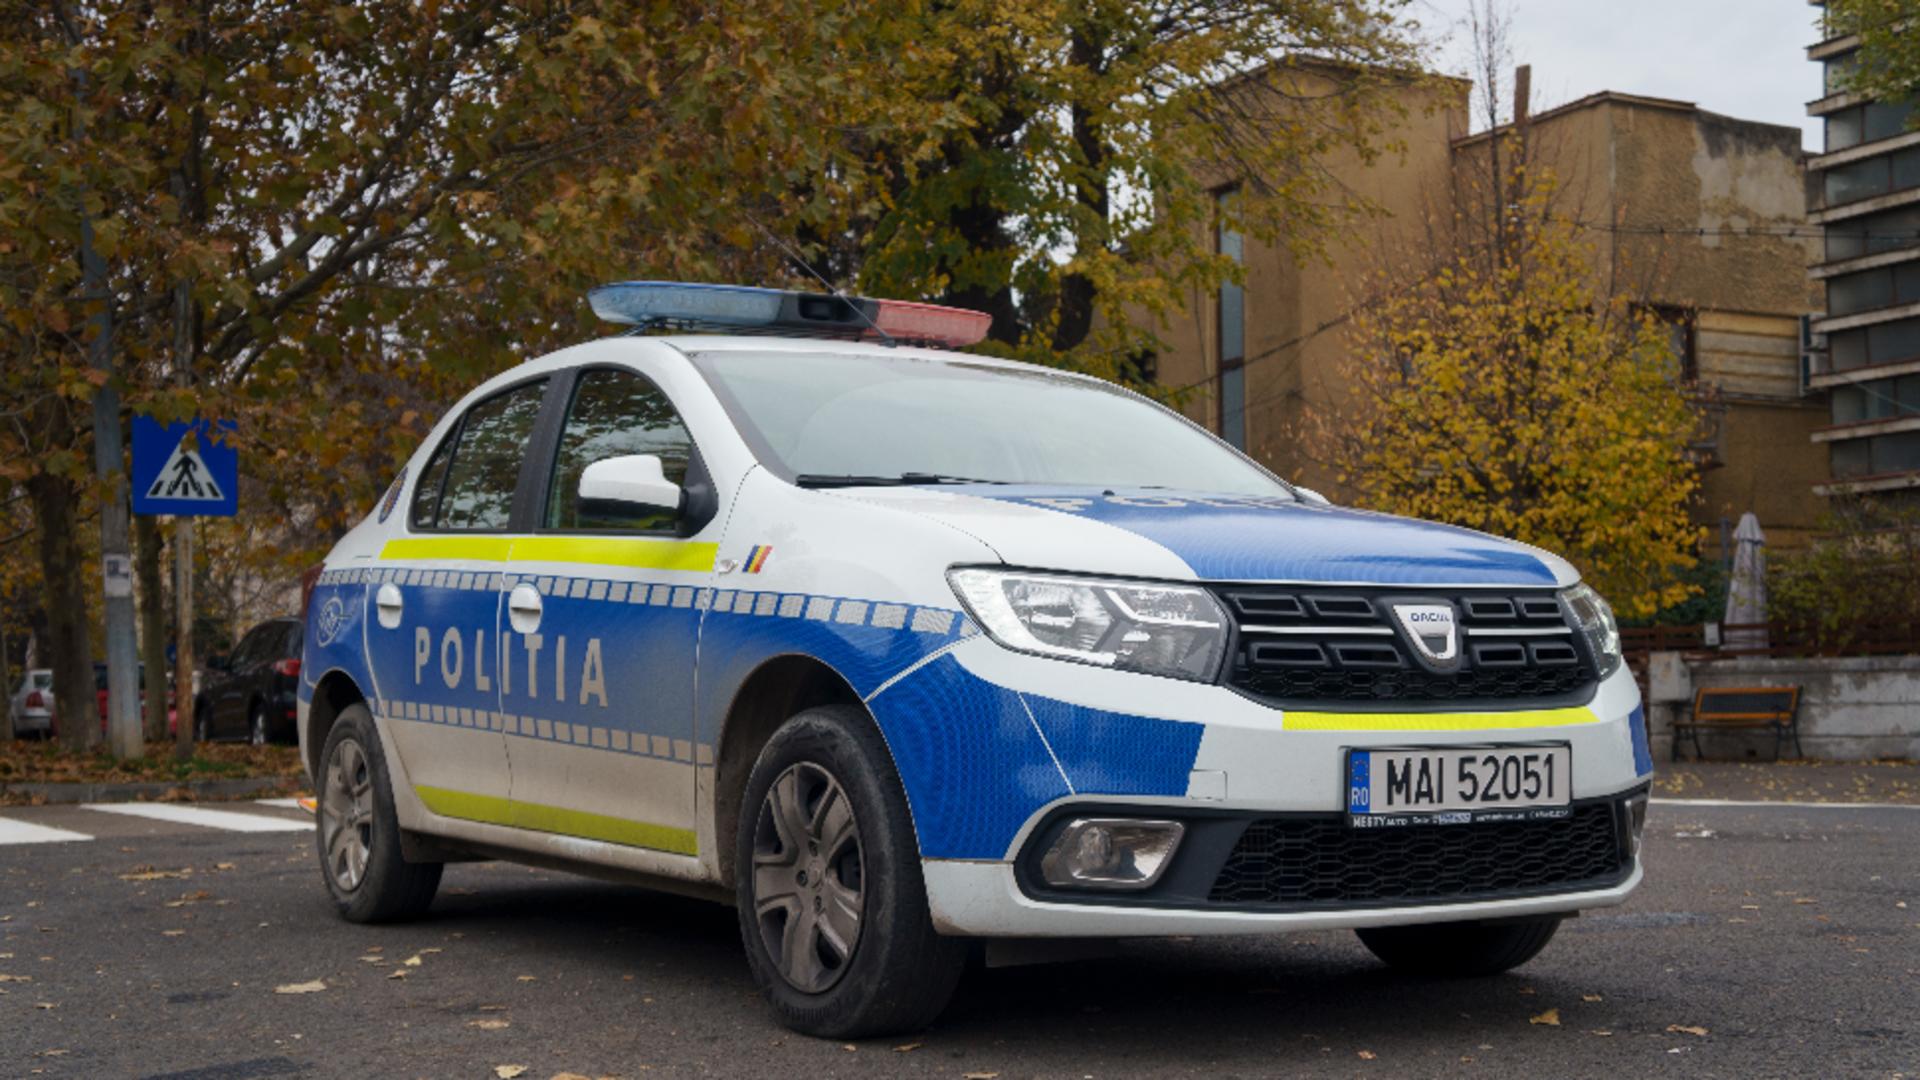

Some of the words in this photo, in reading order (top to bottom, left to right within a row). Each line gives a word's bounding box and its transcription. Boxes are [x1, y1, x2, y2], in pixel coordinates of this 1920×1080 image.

[1410, 612, 1450, 622] DACIA
[415, 626, 609, 707] POLITIA
[1351, 787, 1369, 806] RO
[1386, 757, 1444, 805] MAI
[1458, 753, 1554, 802] 52051
